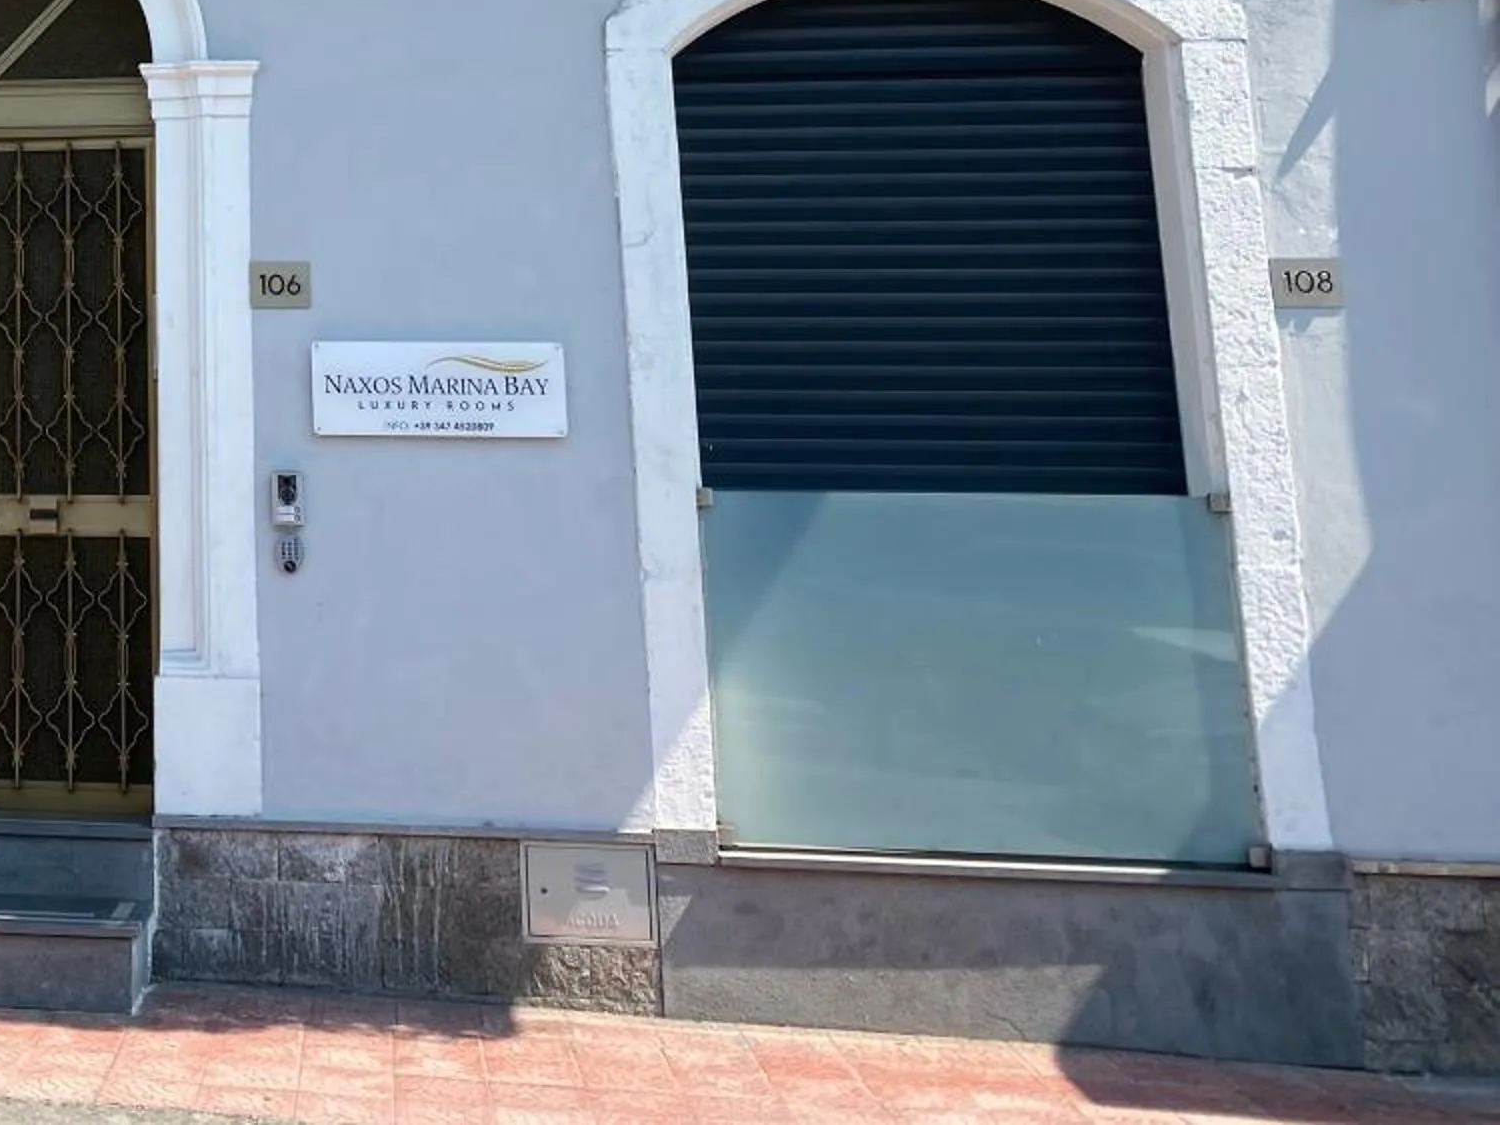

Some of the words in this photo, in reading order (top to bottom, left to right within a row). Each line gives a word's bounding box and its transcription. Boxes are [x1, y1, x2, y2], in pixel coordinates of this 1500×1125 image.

[260, 274, 301, 296] 106
[1283, 270, 1333, 293] 108
[324, 375, 402, 395] NAXOS
[408, 375, 499, 396] MARINA
[505, 375, 548, 396] BAY
[357, 400, 431, 410] LUXURY
[446, 400, 515, 412] ROOMS
